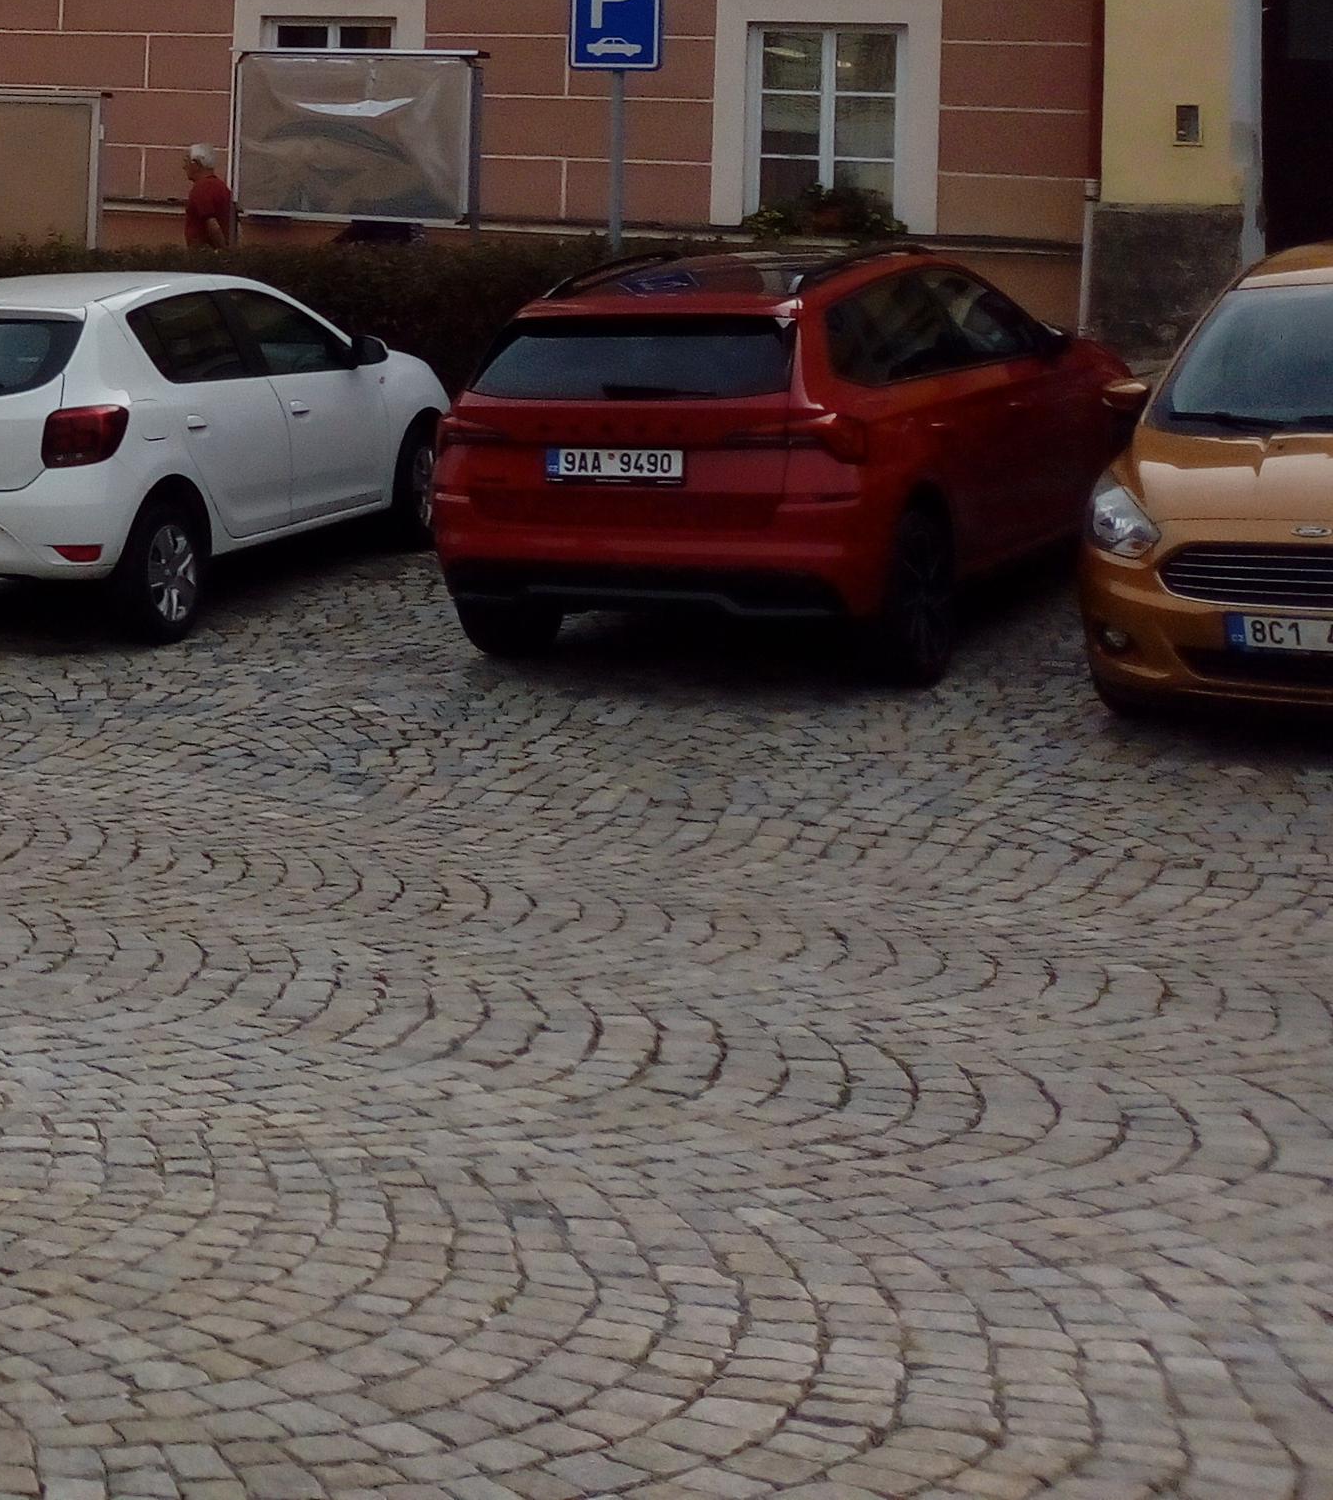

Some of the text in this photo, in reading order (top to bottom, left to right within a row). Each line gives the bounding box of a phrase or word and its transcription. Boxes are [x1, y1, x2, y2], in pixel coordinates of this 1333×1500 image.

[564, 452, 672, 473] 9AA 9490
[1251, 620, 1301, 645] 8C1
